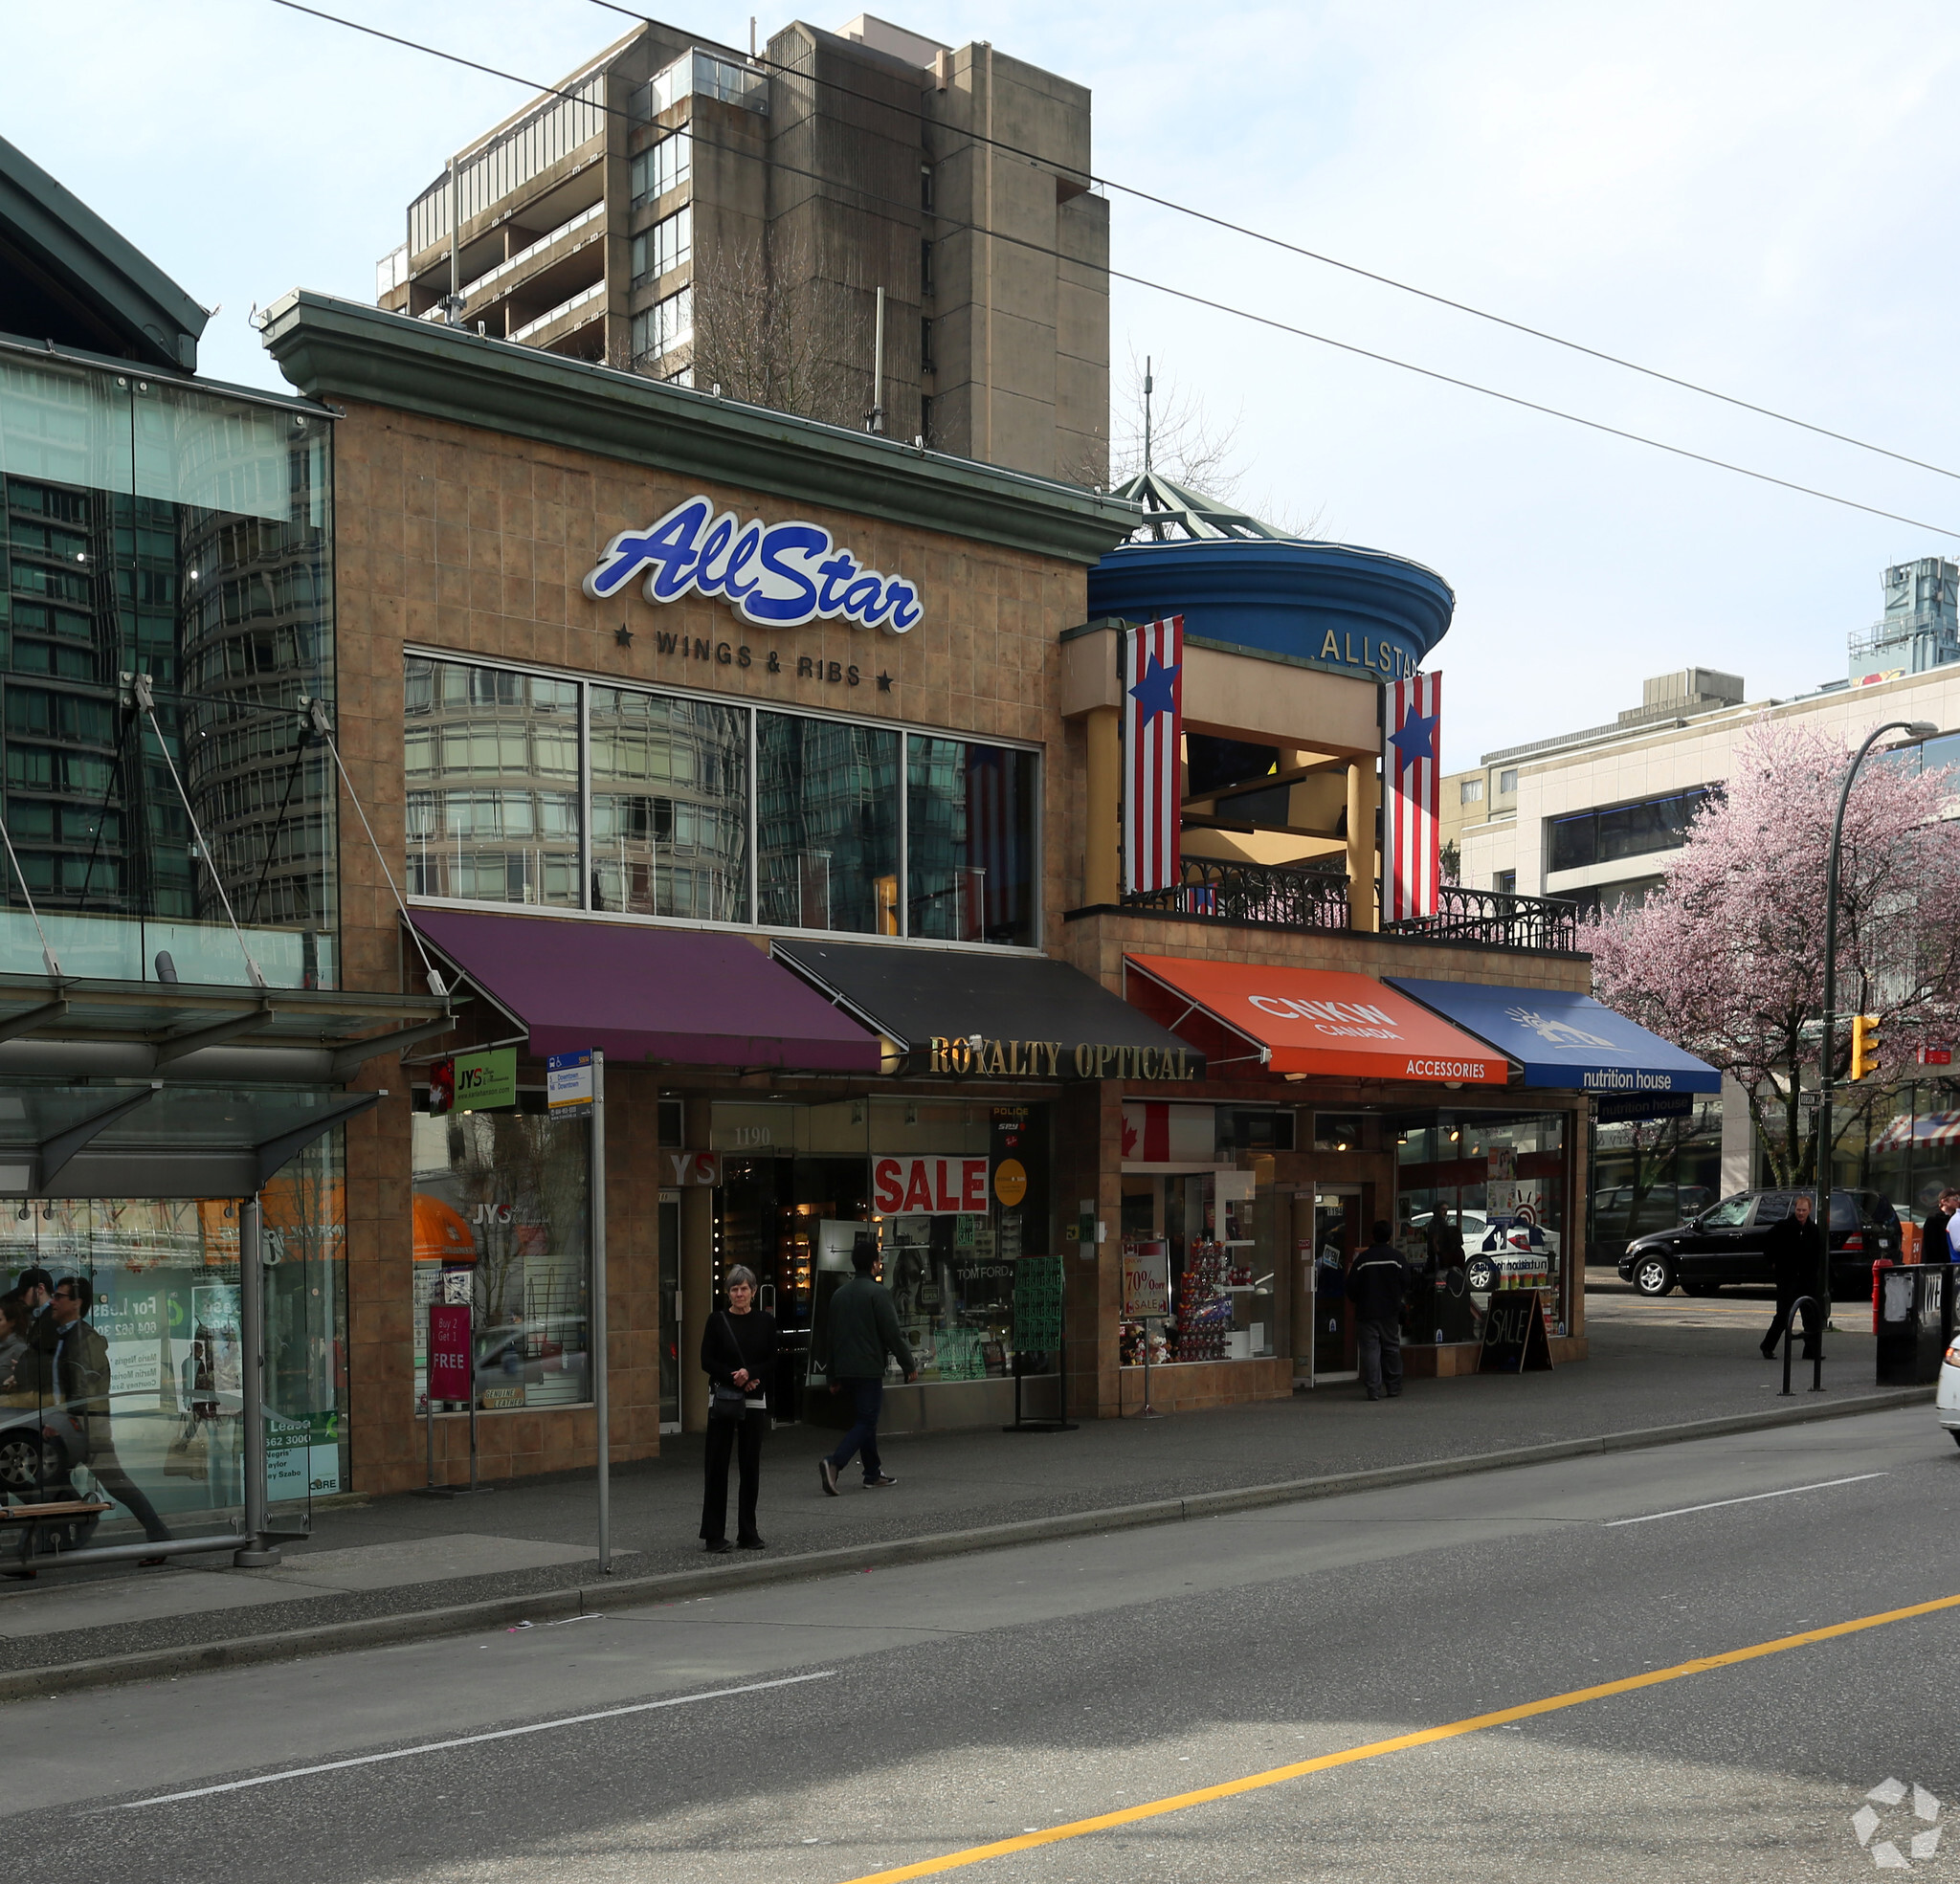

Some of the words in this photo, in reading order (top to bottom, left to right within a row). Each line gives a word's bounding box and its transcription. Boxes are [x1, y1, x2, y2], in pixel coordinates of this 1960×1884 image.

[588, 498, 923, 632] AllStar
[657, 630, 752, 668] WINGS
[768, 652, 781, 673] &
[797, 655, 860, 686] RIBS
[1248, 995, 1398, 1026] CNKW
[1314, 1024, 1405, 1041] CANADA
[929, 1036, 1062, 1077] ROYALTY
[1074, 1042, 1195, 1080] OPTICAL
[558, 1073, 579, 1081] Downtown
[1406, 1059, 1485, 1078] ACCESSORIES
[458, 1068, 482, 1090] JYS
[558, 1081, 579, 1090] Downtown
[1583, 1069, 1634, 1089] nutrition
[1637, 1070, 1672, 1090] house
[993, 1107, 1030, 1116] POLICE
[1601, 1099, 1650, 1117] nutrition
[1653, 1097, 1689, 1112] house
[735, 1126, 771, 1145] 1190
[671, 1153, 716, 1186] YS
[875, 1159, 988, 1213] SALE
[473, 1203, 512, 1224] JYS
[958, 1232, 973, 1245] SALE
[1325, 1247, 1339, 1264] OPEN
[957, 1266, 979, 1280] TOM
[981, 1265, 1009, 1278] FORD
[1135, 1299, 1158, 1310] SALE
[438, 1318, 451, 1329] Buy
[453, 1319, 457, 1328] 2
[1485, 1308, 1528, 1346] SALE
[437, 1331, 450, 1341] Get
[453, 1331, 457, 1341] 1
[434, 1353, 464, 1369] FREE
[486, 1388, 515, 1398] GENUINE
[494, 1398, 523, 1407] LEATHER
[270, 1419, 311, 1432] Lease
[285, 1434, 312, 1445] 3000
[278, 1470, 301, 1478] Szabo
